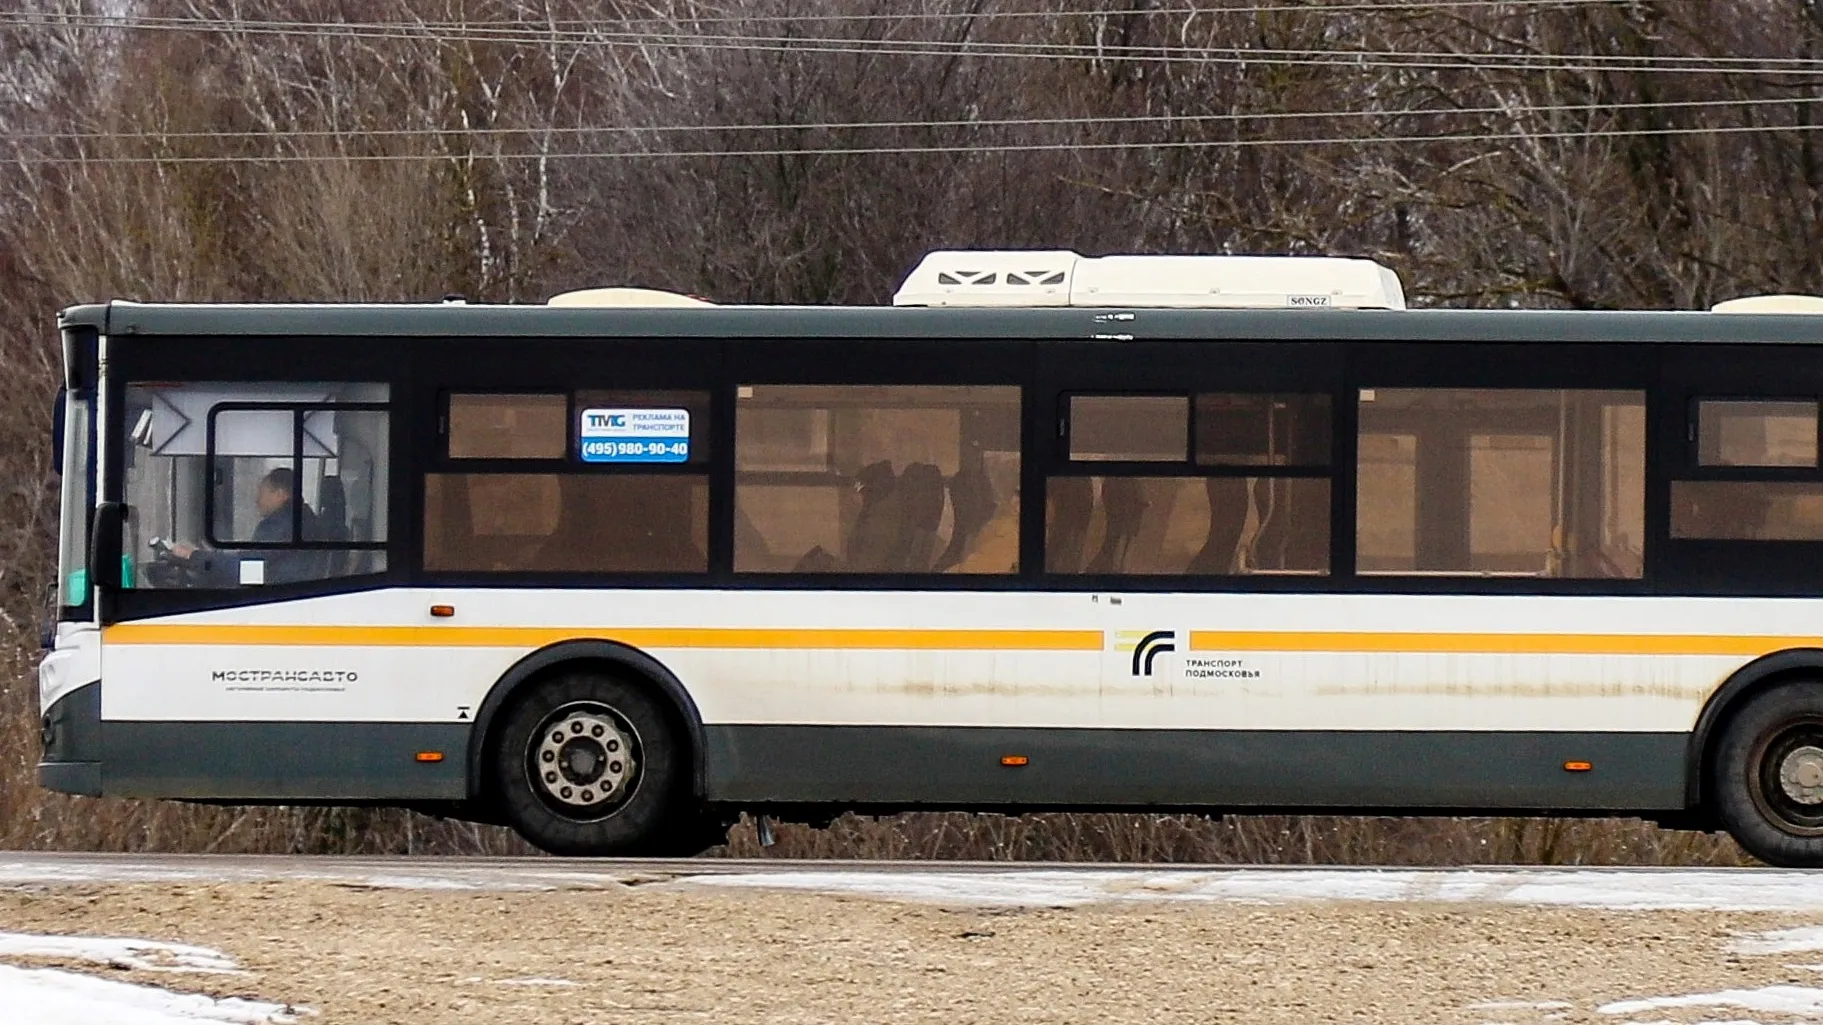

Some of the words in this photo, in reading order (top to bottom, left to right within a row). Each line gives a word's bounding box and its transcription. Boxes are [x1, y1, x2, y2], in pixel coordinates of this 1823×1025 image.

[1291, 297, 1327, 306] SONGZ
[632, 413, 672, 421] РЕКЛАМА
[673, 413, 686, 421] НА
[633, 423, 685, 432] ТРАНСПОРТЕ
[211, 670, 358, 682] МОСТРАНСАВТО
[1185, 669, 1260, 678] ПОДМОСКОВЬЯ
